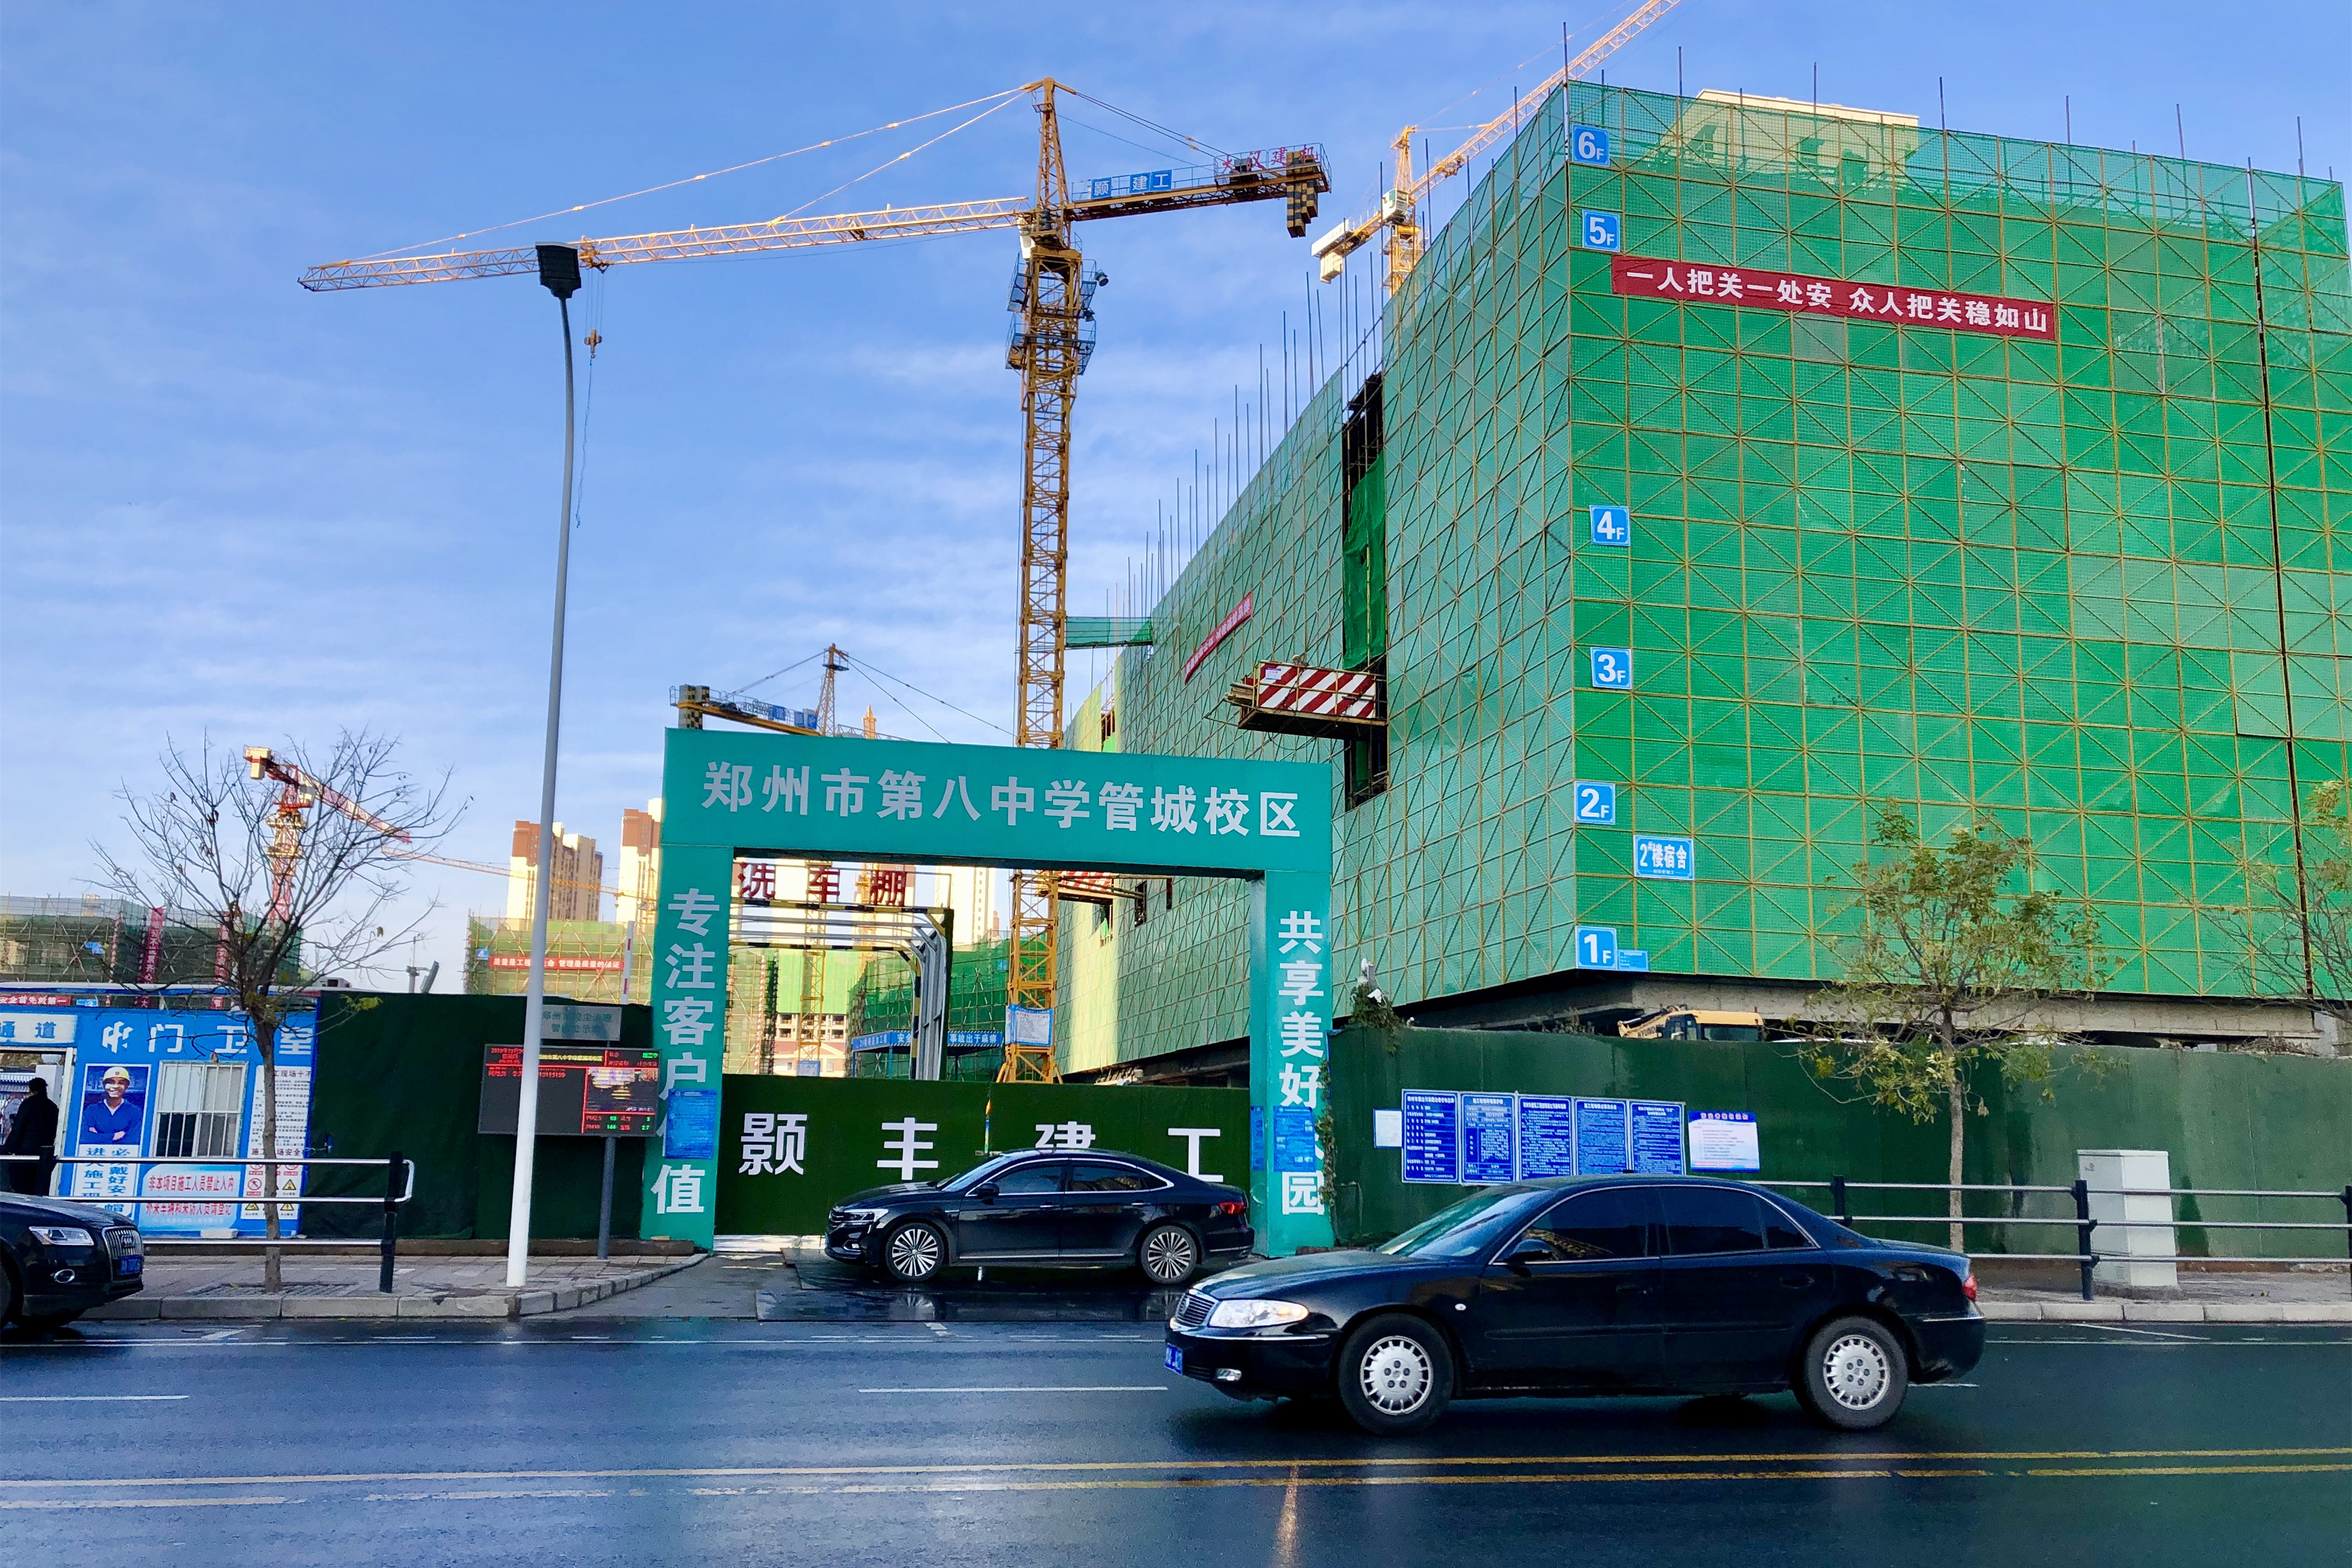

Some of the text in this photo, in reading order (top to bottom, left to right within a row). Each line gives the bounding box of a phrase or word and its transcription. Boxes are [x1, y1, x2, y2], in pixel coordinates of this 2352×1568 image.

[1578, 131, 1605, 160] 6F
[1590, 216, 1615, 246] 5F
[1627, 267, 2048, 333] 一人把关一处安 众人把关稳如山
[1597, 511, 1625, 540] 4F
[1598, 654, 1626, 682] 3F
[702, 761, 1300, 838] 郑州市第八中学管城校区
[1581, 788, 1609, 818] 2F
[737, 862, 907, 907] 洗车棚
[1584, 933, 1612, 964] 1F
[148, 1024, 312, 1055] 门卫室
[651, 888, 720, 1214] 专注客户值
[1278, 911, 1325, 1215] 共享美好园
